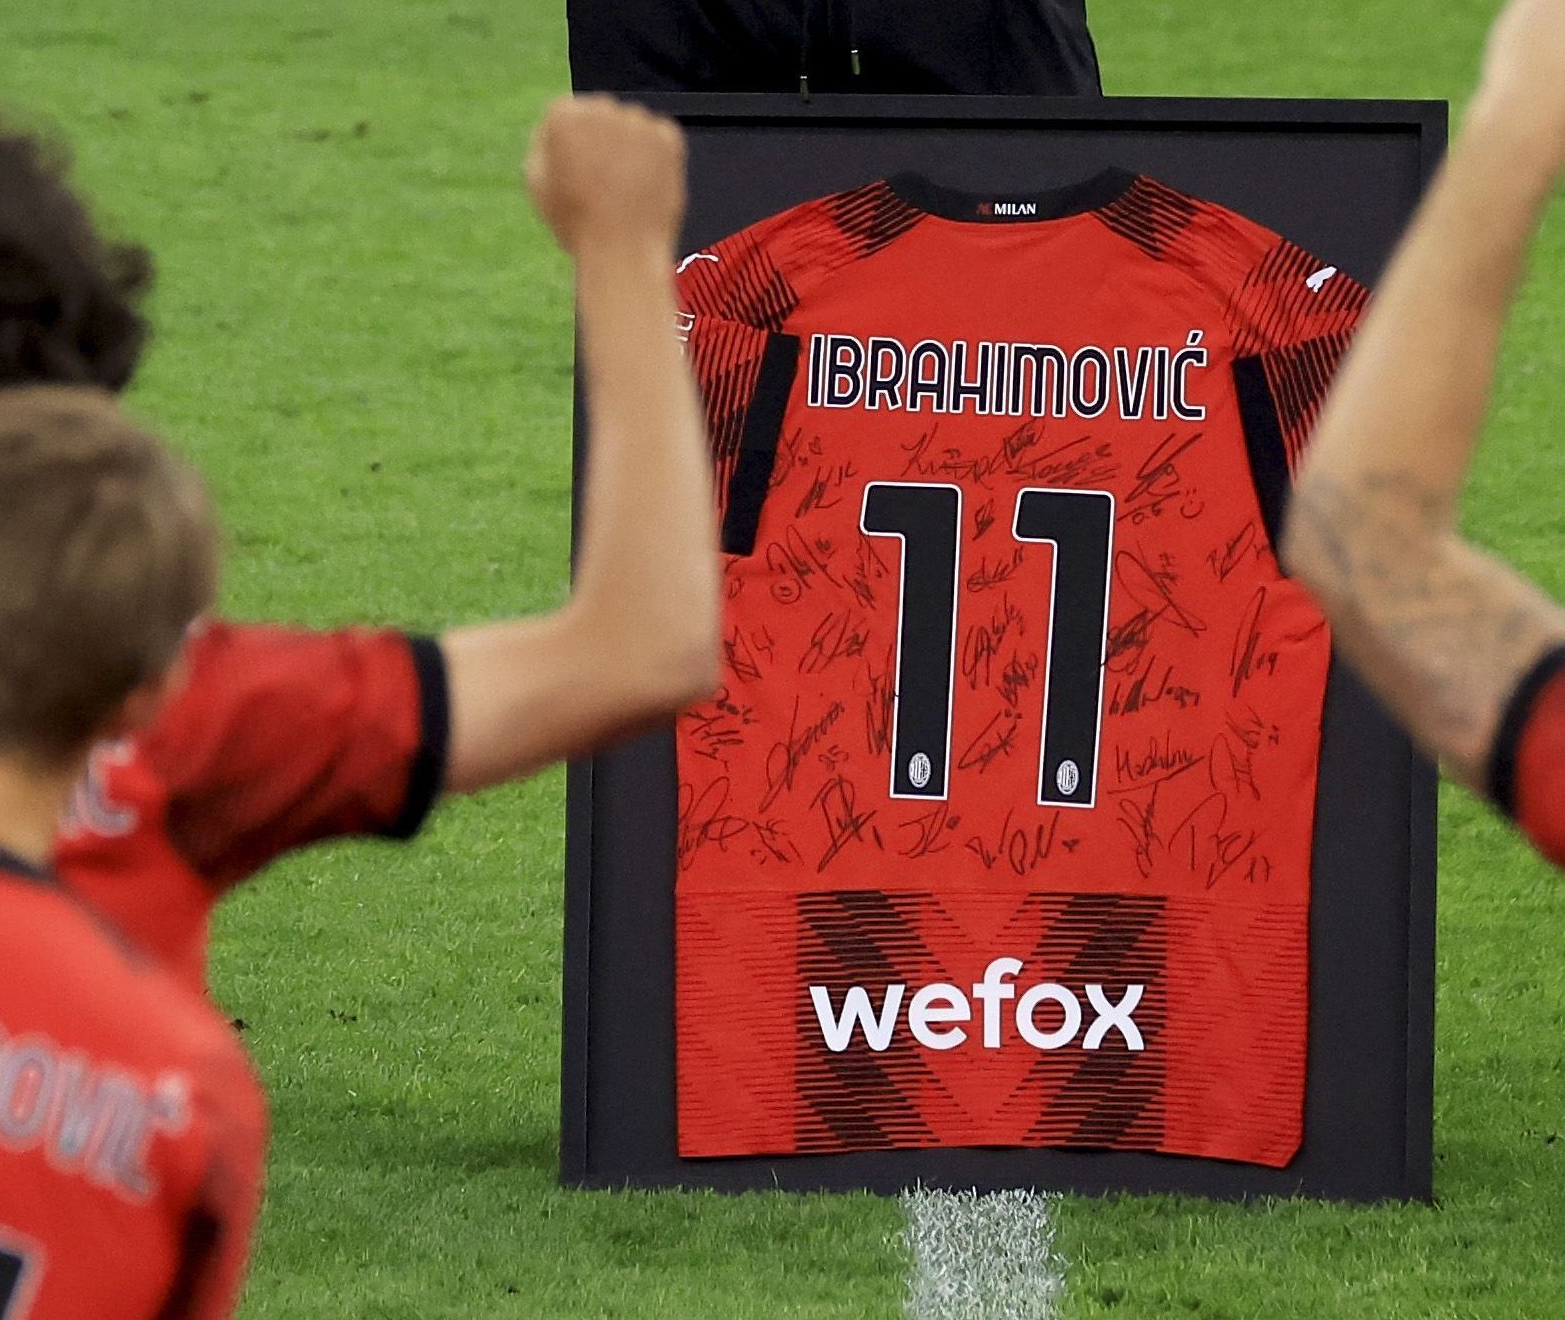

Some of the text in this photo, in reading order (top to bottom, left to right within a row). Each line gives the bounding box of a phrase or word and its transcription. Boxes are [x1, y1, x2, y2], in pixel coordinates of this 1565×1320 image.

[994, 203, 1036, 215] MILAN
[807, 329, 1207, 421] IBRAHIMOVIĆ
[859, 482, 1116, 809] 11
[809, 957, 1145, 1053] wefox
